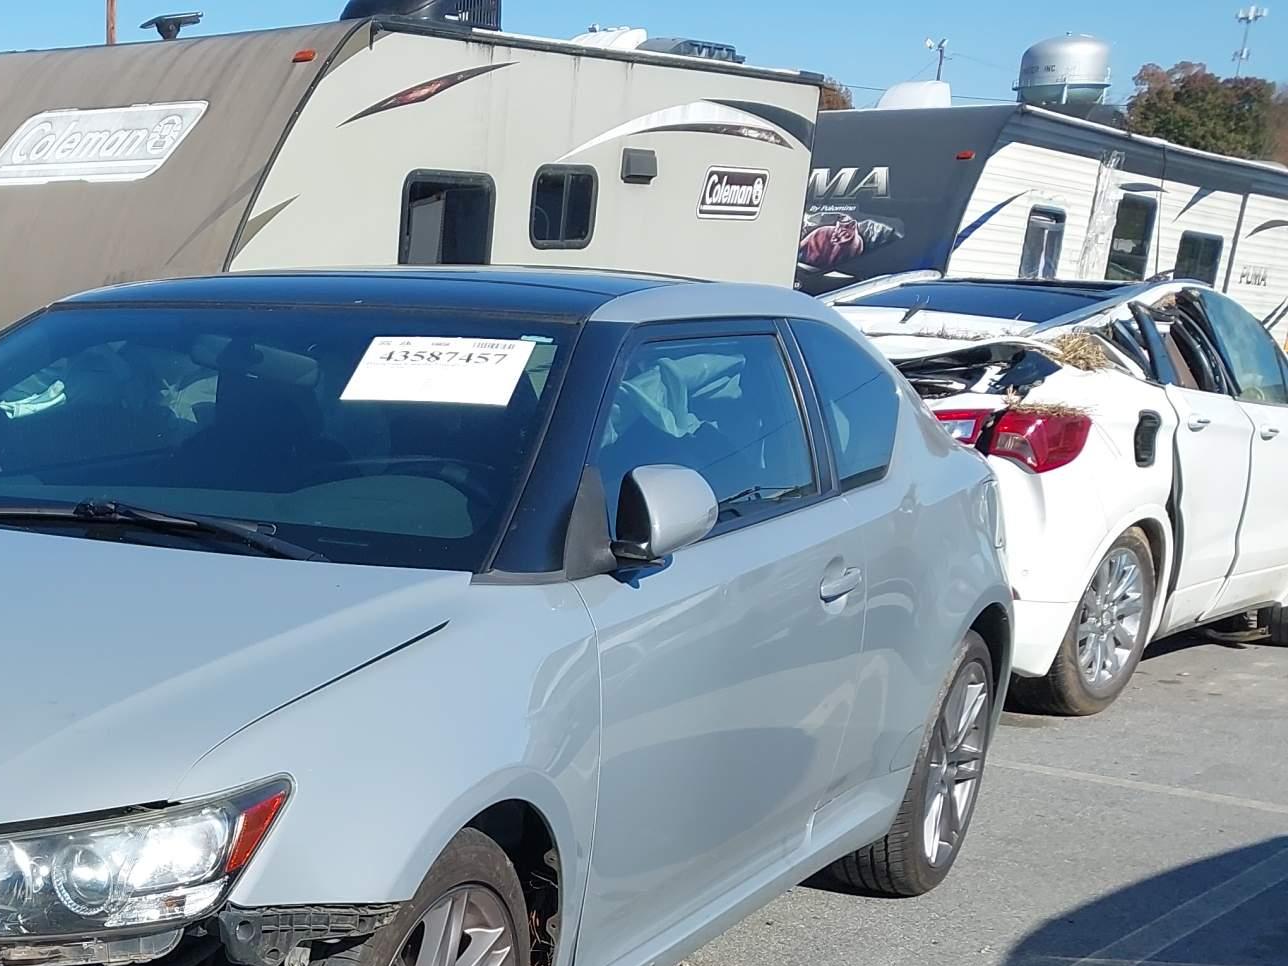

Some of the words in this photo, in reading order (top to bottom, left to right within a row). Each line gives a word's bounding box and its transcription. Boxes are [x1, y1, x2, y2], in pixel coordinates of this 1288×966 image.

[12, 119, 150, 164] Coleman
[705, 174, 754, 205] Coleman
[379, 350, 509, 366] 43587457
